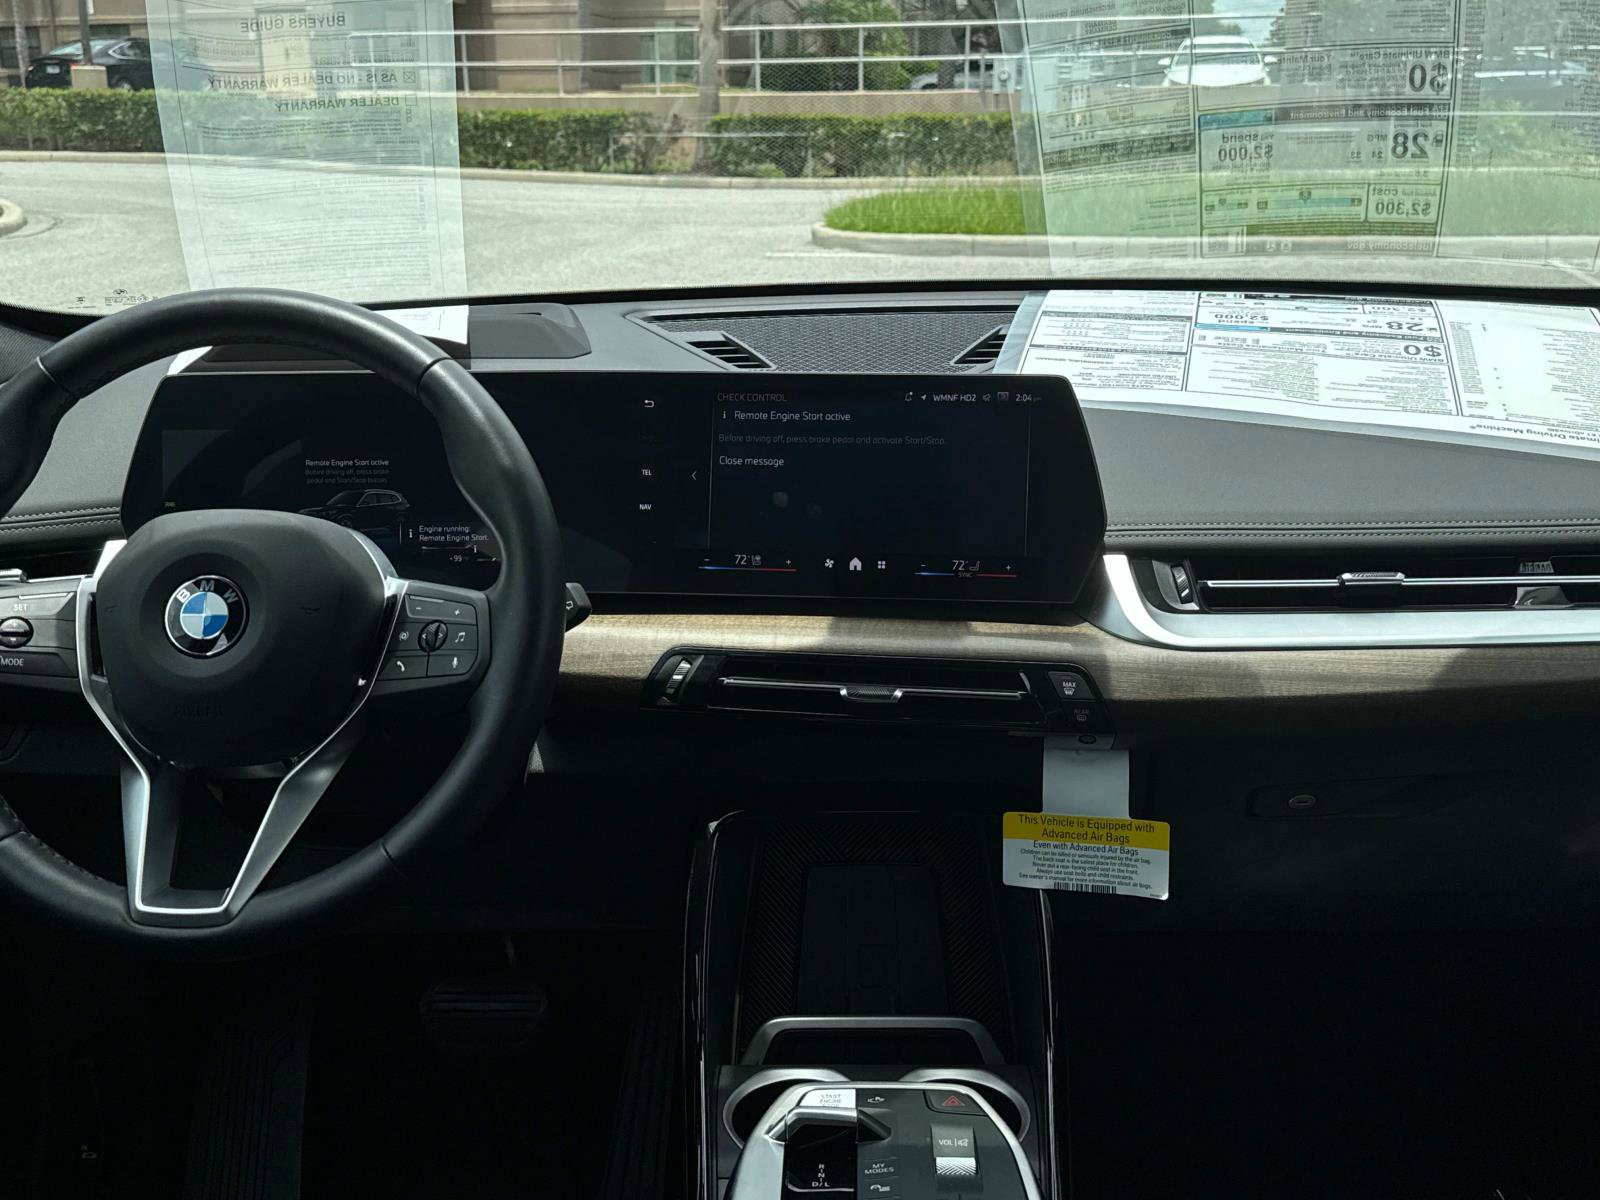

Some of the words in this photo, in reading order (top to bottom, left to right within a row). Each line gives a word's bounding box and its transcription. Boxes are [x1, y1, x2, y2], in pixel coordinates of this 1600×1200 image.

[1385, 321, 1424, 332] 28
[1403, 345, 1442, 358] $0
[717, 392, 745, 402] CHECK
[748, 393, 787, 403] CONTROL
[932, 393, 960, 403] WMNF
[960, 393, 977, 403] HD2
[1015, 393, 1032, 403] 2:04
[734, 410, 769, 420] Remote
[770, 411, 801, 422] Engine
[802, 411, 824, 421] Start
[825, 411, 851, 421] active
[855, 435, 871, 444] and
[331, 459, 354, 467] Engine
[719, 456, 743, 465] Close
[744, 457, 785, 468] message
[640, 468, 652, 477] TEL
[638, 503, 652, 511] NAV
[418, 525, 443, 534] Engine
[446, 534, 470, 543] Engine
[175, 579, 239, 604] BMW
[0, 658, 25, 667] MODE
[1062, 680, 1077, 689] MAX
[1019, 813, 1038, 825] This
[1040, 815, 1075, 829] Vehicle
[1076, 818, 1085, 829] is
[1087, 818, 1132, 834] Equipped
[1134, 822, 1155, 833] with
[1041, 828, 1088, 841] Advanced
[1090, 830, 1103, 842] Air
[1106, 831, 1130, 846] Bags
[1033, 840, 1052, 849] Even
[1052, 842, 1069, 850] with
[1069, 843, 1107, 853] Advanced
[1107, 845, 1118, 854] Air
[1119, 847, 1139, 857] Bags
[938, 1138, 954, 1147] VOL
[864, 1167, 895, 1175] MODES
